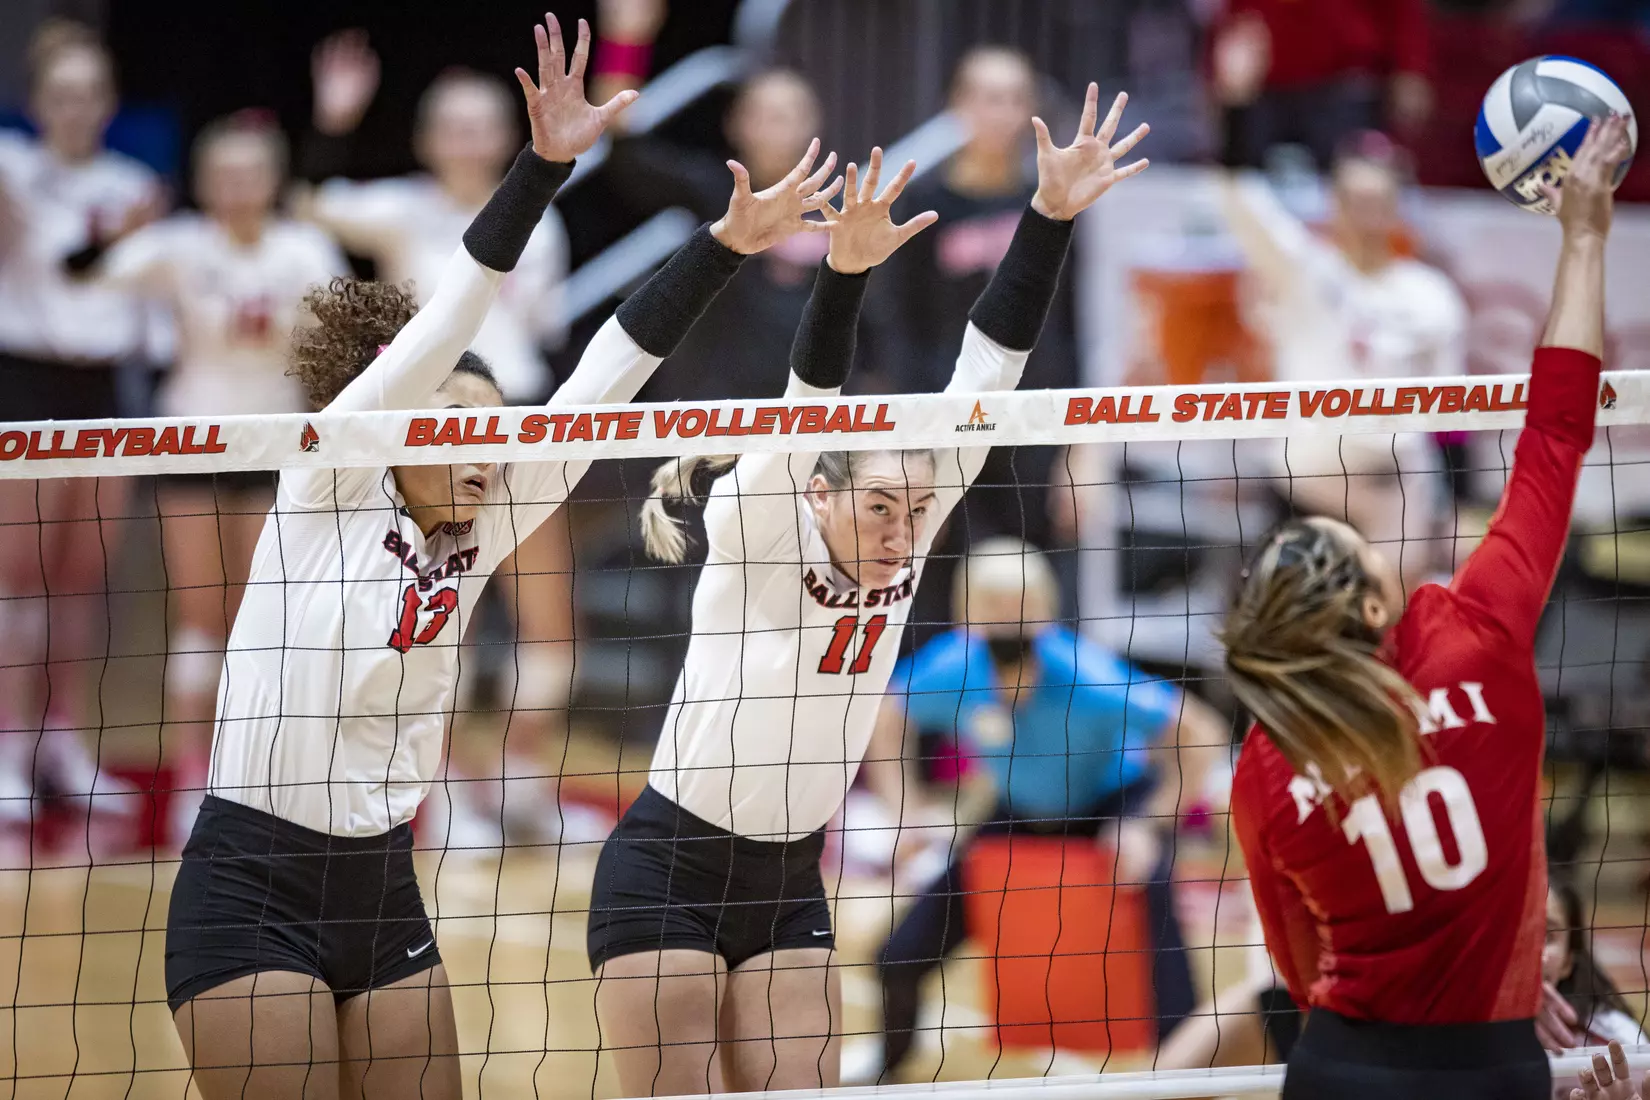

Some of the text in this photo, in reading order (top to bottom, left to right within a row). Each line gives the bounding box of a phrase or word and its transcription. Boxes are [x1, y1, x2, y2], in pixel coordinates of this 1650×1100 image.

[404, 403, 896, 447] BALL STATE VOLLEYBALL
[1064, 384, 1528, 425] BALL STATE VOLLEYBALL
[0, 425, 227, 461] OLLEYBALL
[955, 423, 997, 432] ACTIVE ANKLE
[803, 567, 859, 609] BALL
[817, 614, 888, 675] 11
[1340, 765, 1489, 914] 10
